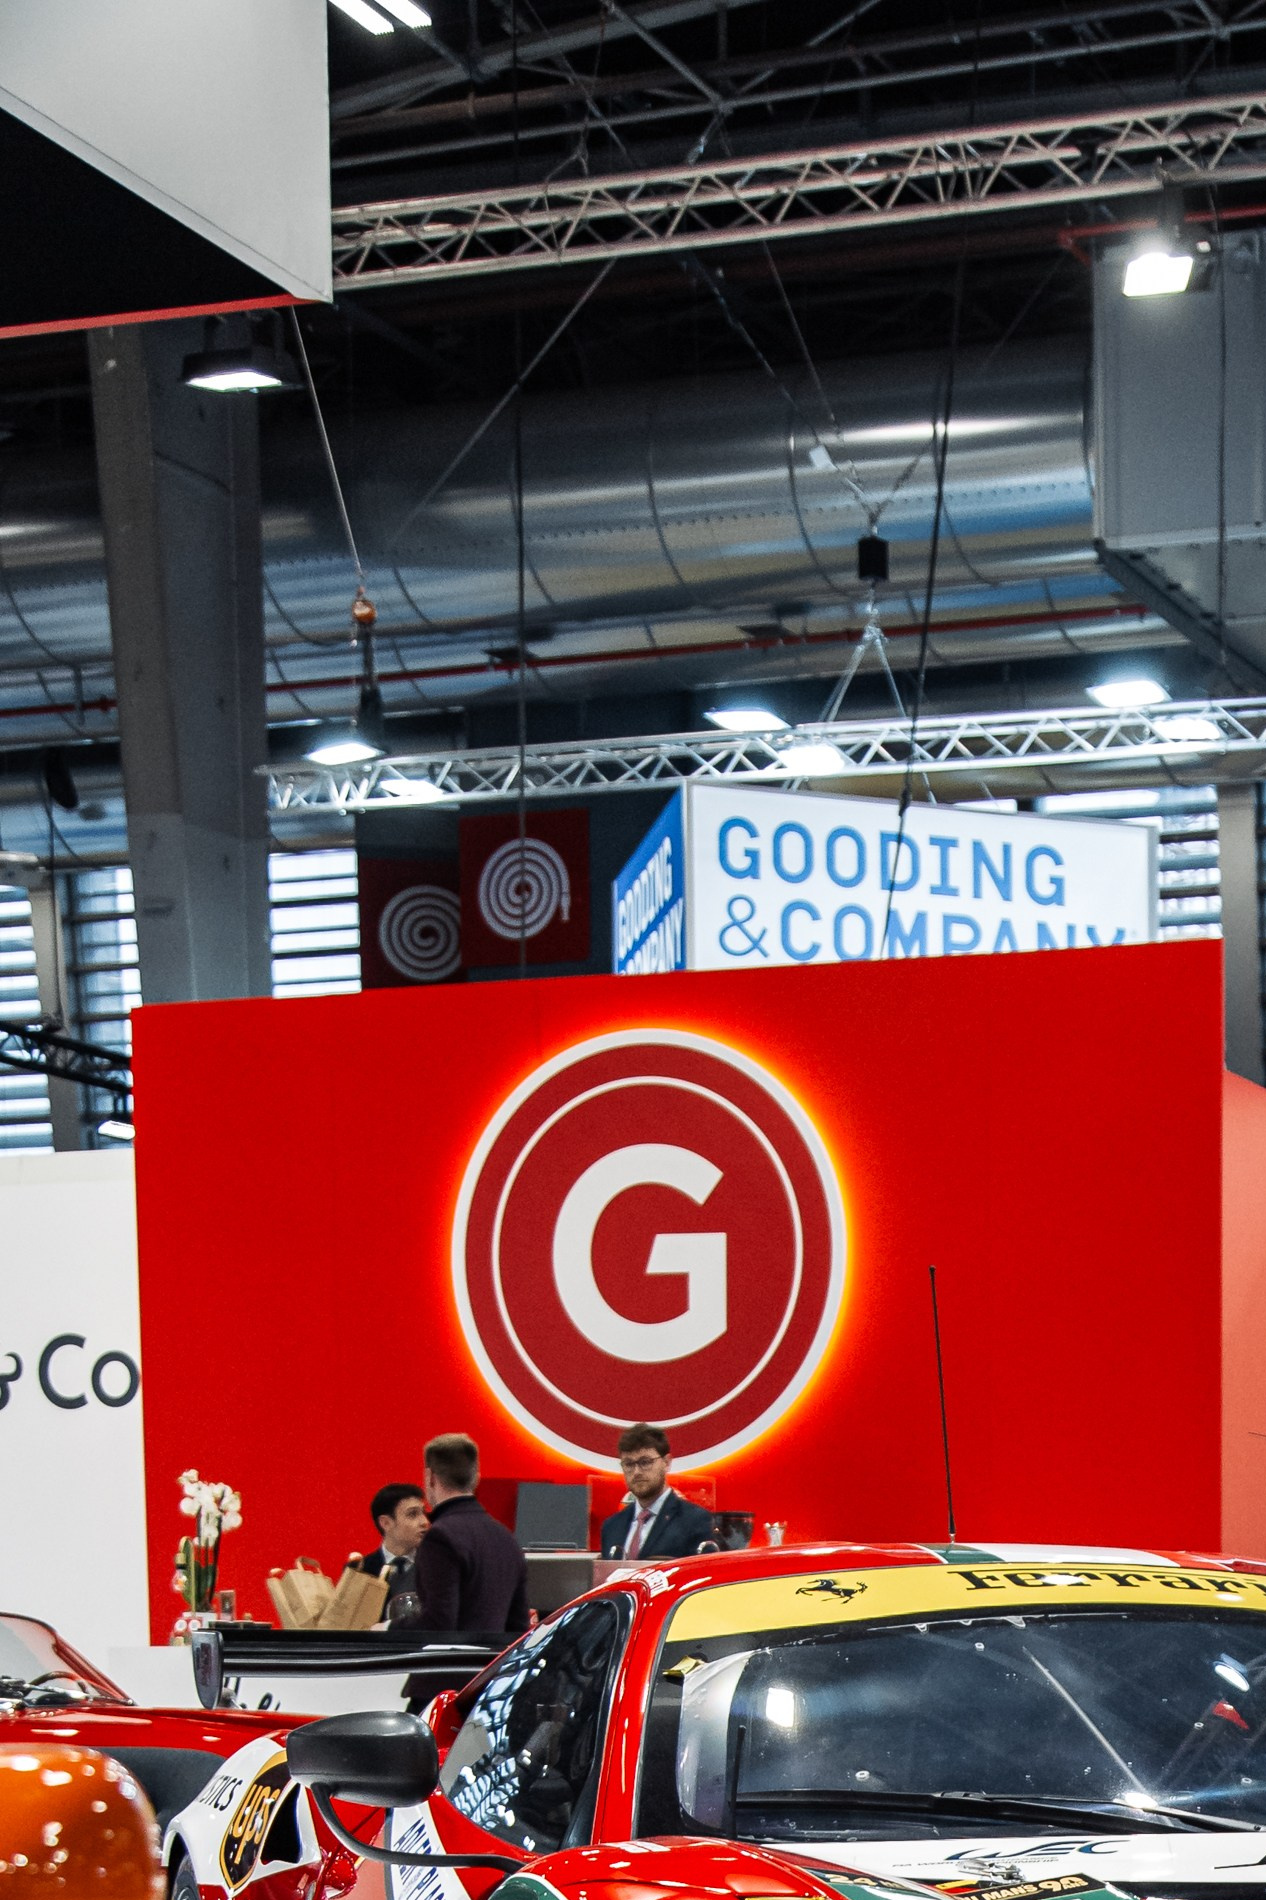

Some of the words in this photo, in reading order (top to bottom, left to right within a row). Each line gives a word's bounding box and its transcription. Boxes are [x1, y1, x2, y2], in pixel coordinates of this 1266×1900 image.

[618, 836, 673, 962] GOODING
[718, 815, 1066, 907] GOODING
[552, 1142, 728, 1364] G
